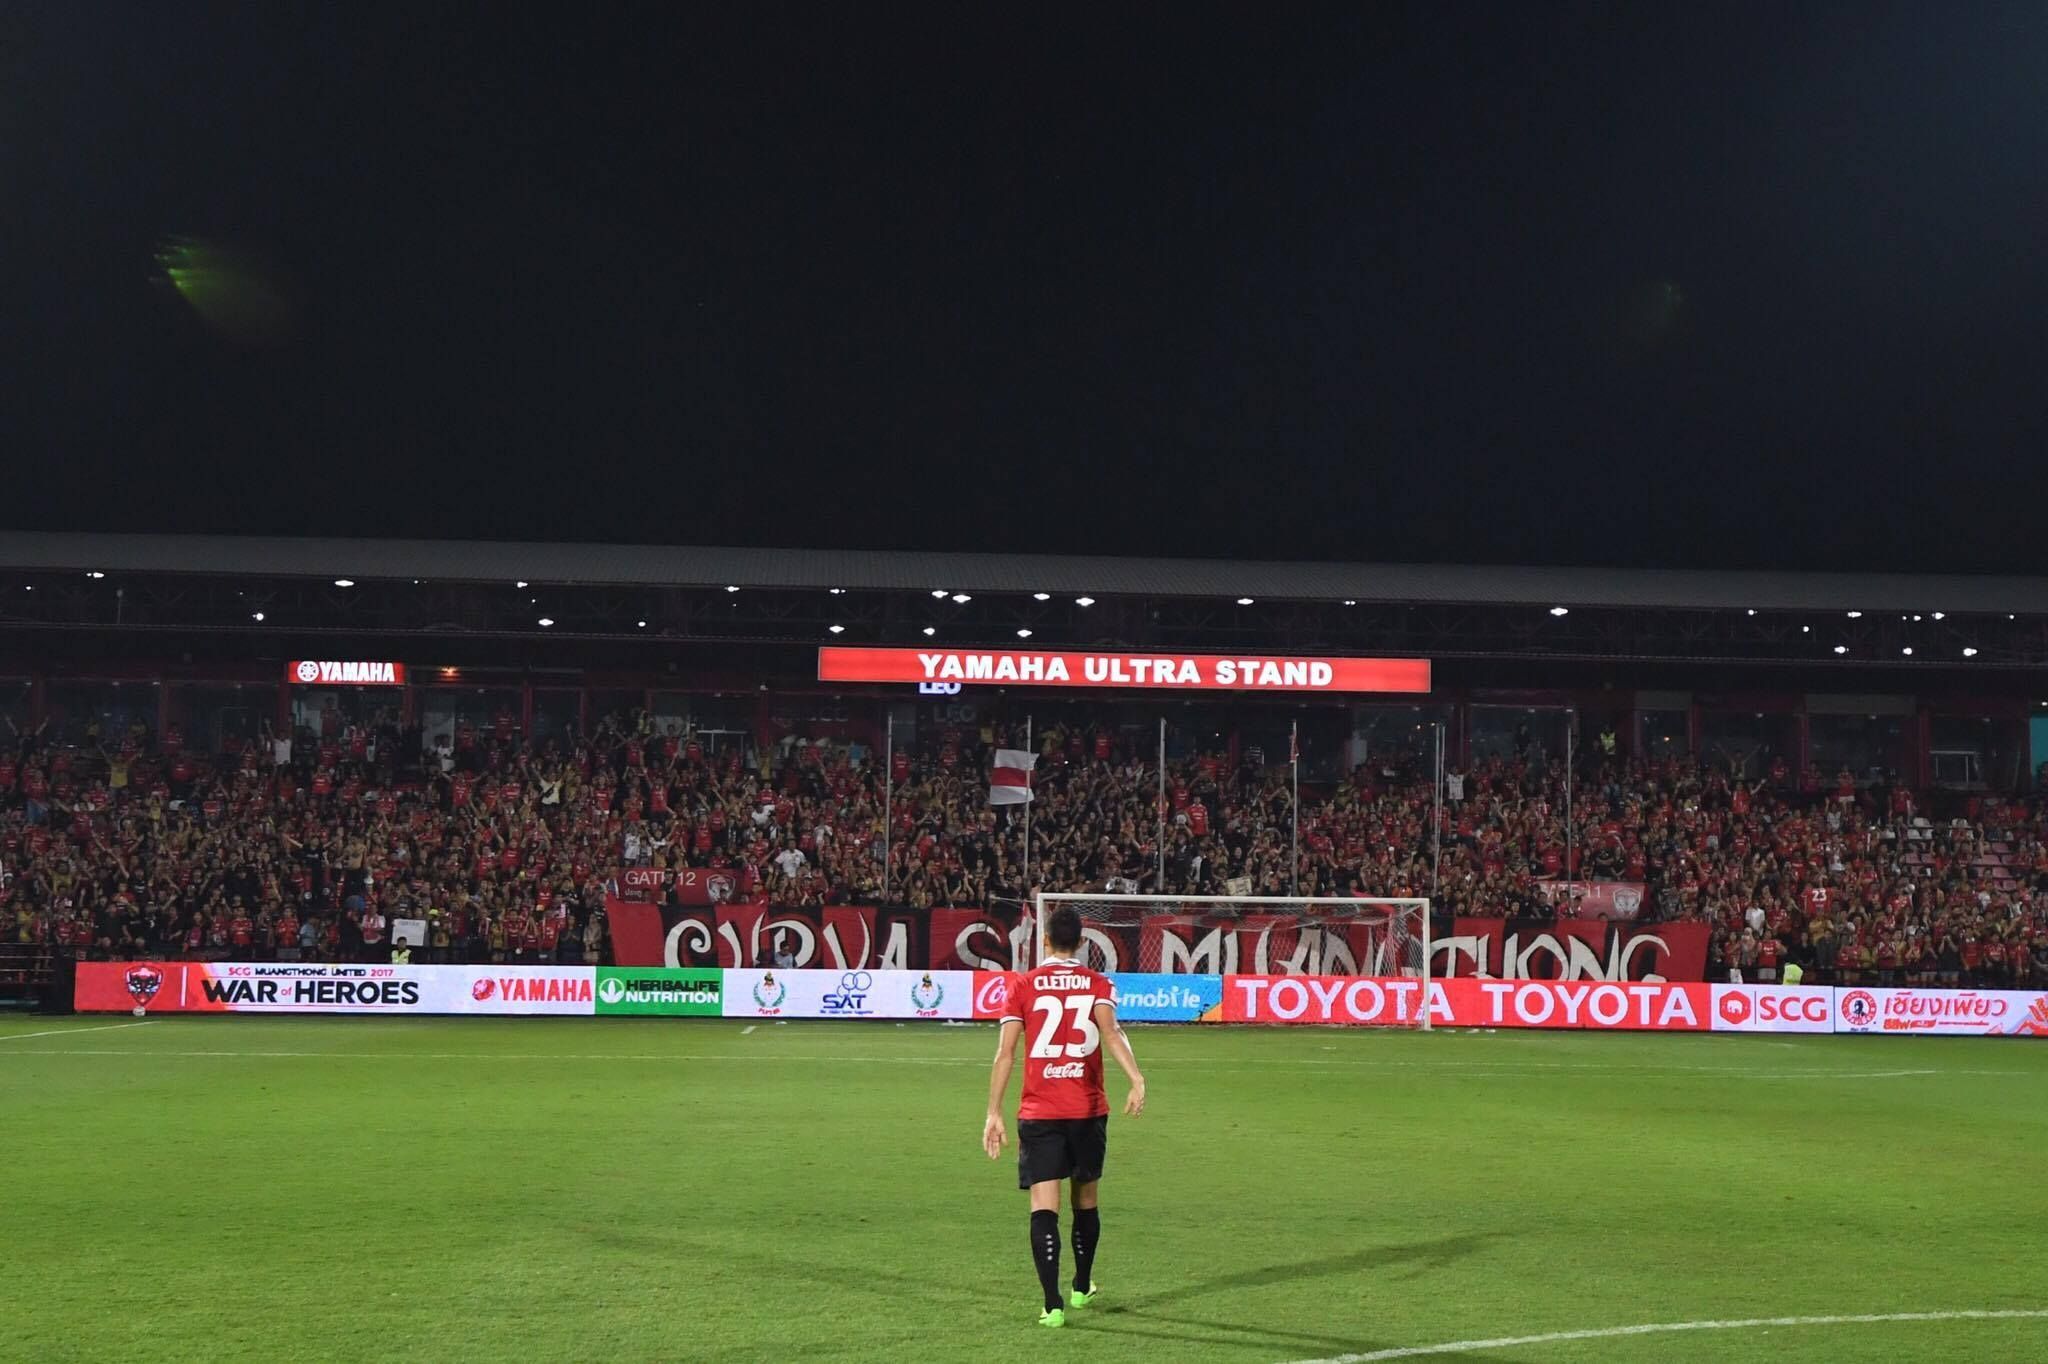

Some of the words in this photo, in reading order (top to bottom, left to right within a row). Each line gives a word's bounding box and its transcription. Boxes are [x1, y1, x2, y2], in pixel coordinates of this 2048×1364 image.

[319, 661, 395, 681] YAMAHA
[918, 653, 1069, 681] YAMAHA
[1084, 657, 1201, 683] ULTRA
[1215, 660, 1333, 686] STAND
[677, 871, 696, 886] 12
[1540, 884, 1580, 898] ATE
[1812, 888, 1827, 901] 23
[954, 922, 1118, 973] SD
[228, 967, 251, 976] SCG
[255, 967, 326, 976] MUANGTHONG
[332, 968, 366, 977] UNITED
[370, 969, 394, 977] 2017
[1034, 974, 1091, 991] CLEITON
[201, 980, 278, 1003] WAR
[281, 986, 292, 997] of
[295, 981, 419, 1004] HEROES
[499, 978, 592, 1002] YAMAHA
[626, 980, 720, 992] HERBALIFE
[626, 991, 719, 1004] NUTRITION
[823, 994, 867, 1009] SAT
[1116, 986, 1201, 1009] -mobile
[1235, 979, 1455, 1021] TOYOTA
[1481, 983, 1697, 1025] TOYOTA
[1760, 996, 1827, 1022] SCG
[1030, 995, 1100, 1059] 23
